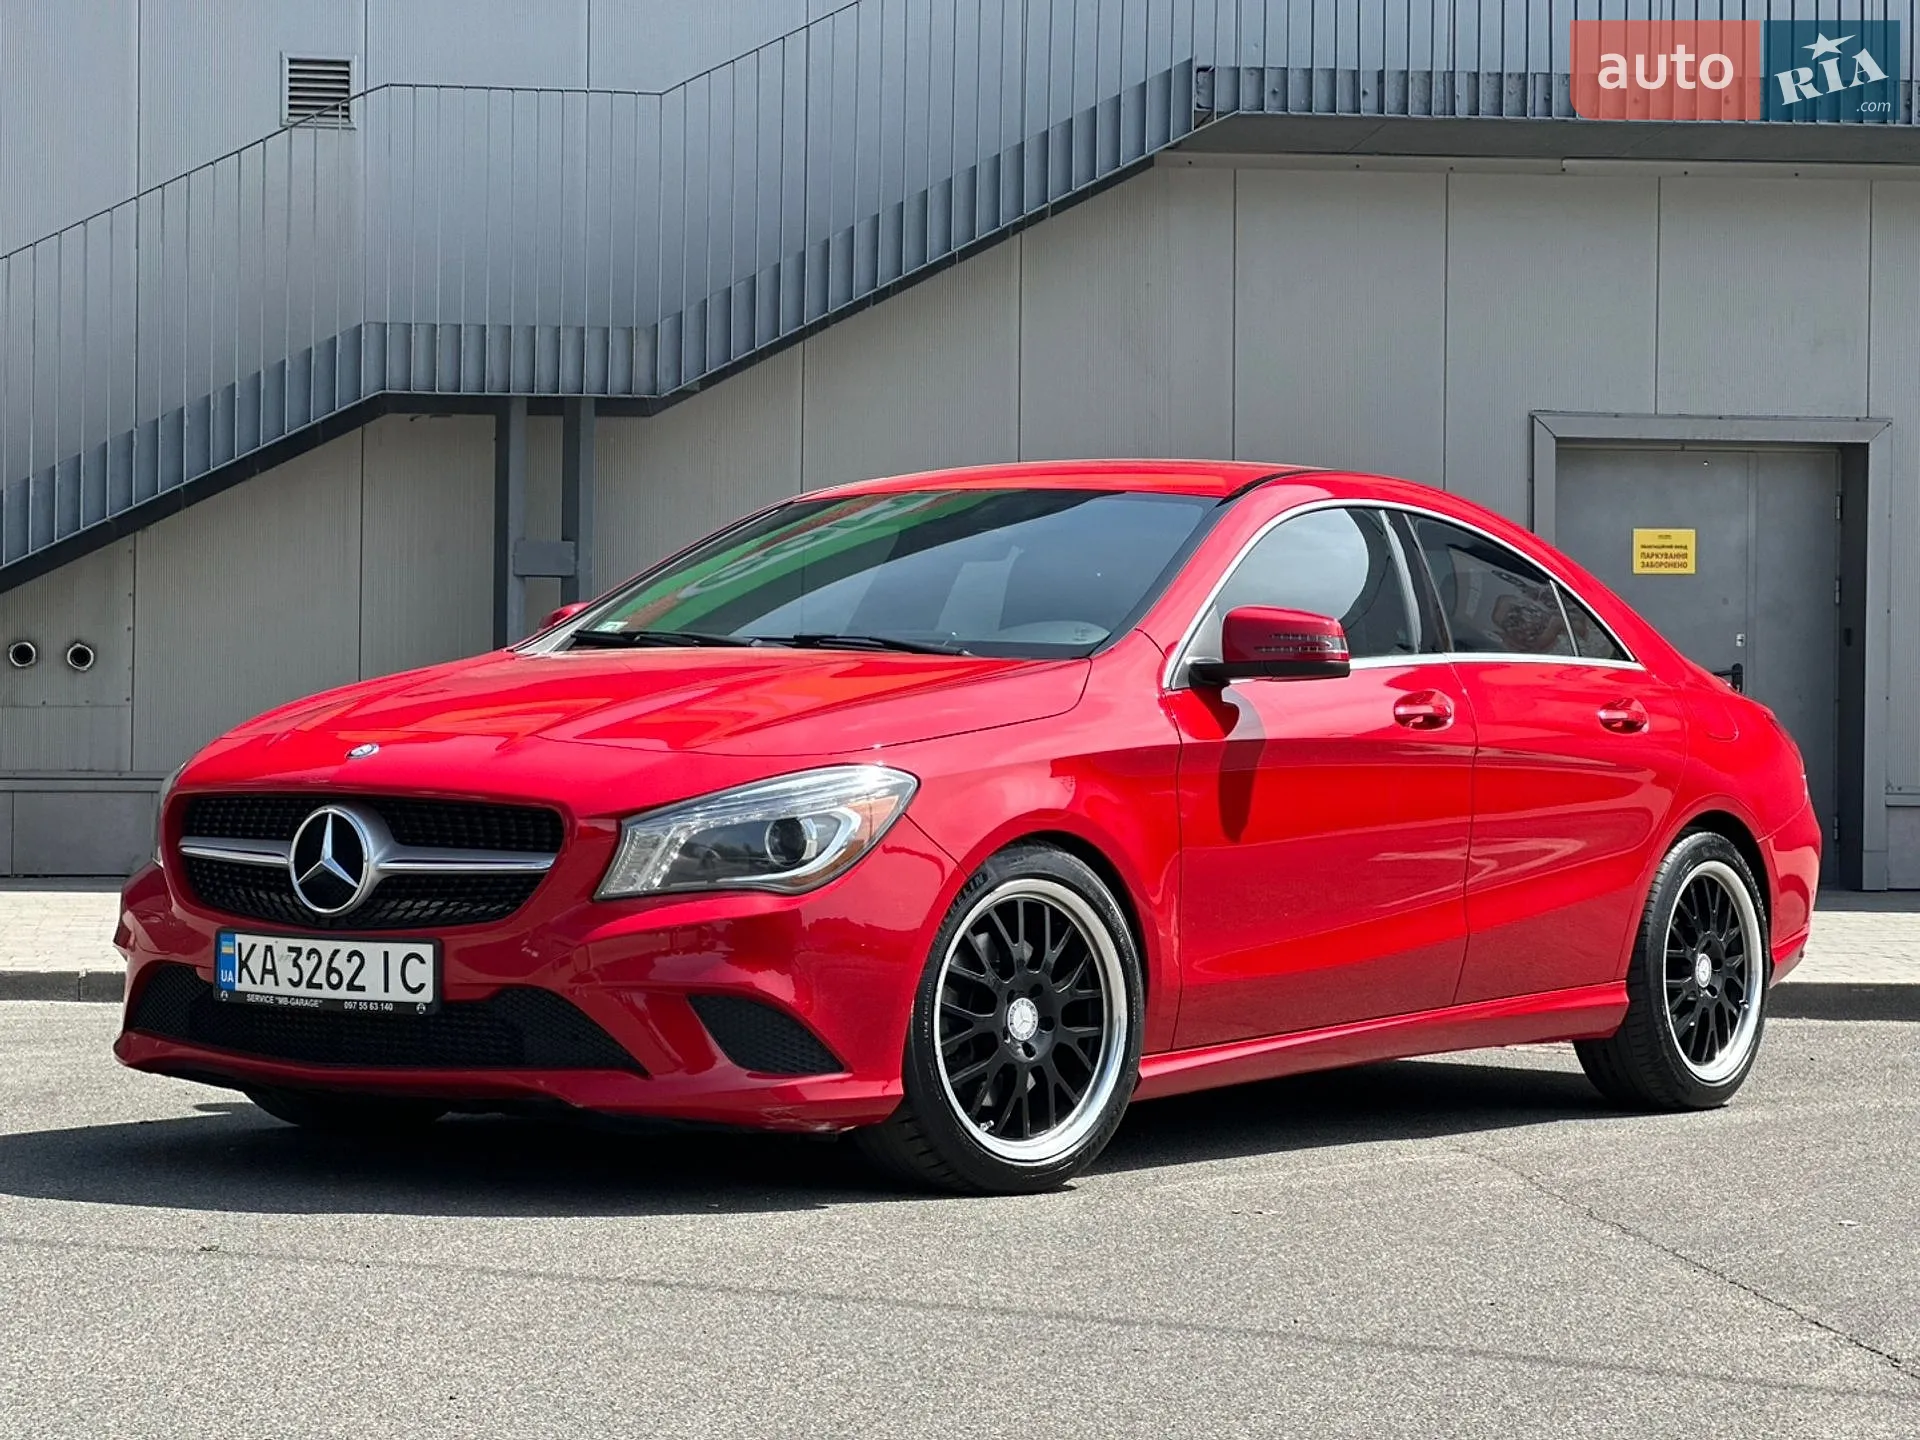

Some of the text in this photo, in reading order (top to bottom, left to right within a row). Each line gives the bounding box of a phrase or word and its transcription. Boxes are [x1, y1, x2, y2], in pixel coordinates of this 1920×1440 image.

[1640, 561, 1688, 569] ЗАБОРОНЕНО
[237, 942, 427, 994] KA 3262 IC
[221, 970, 234, 983] UA
[246, 993, 275, 1004] SERVICE
[358, 1002, 368, 1010] 55
[380, 1002, 393, 1011] 140
